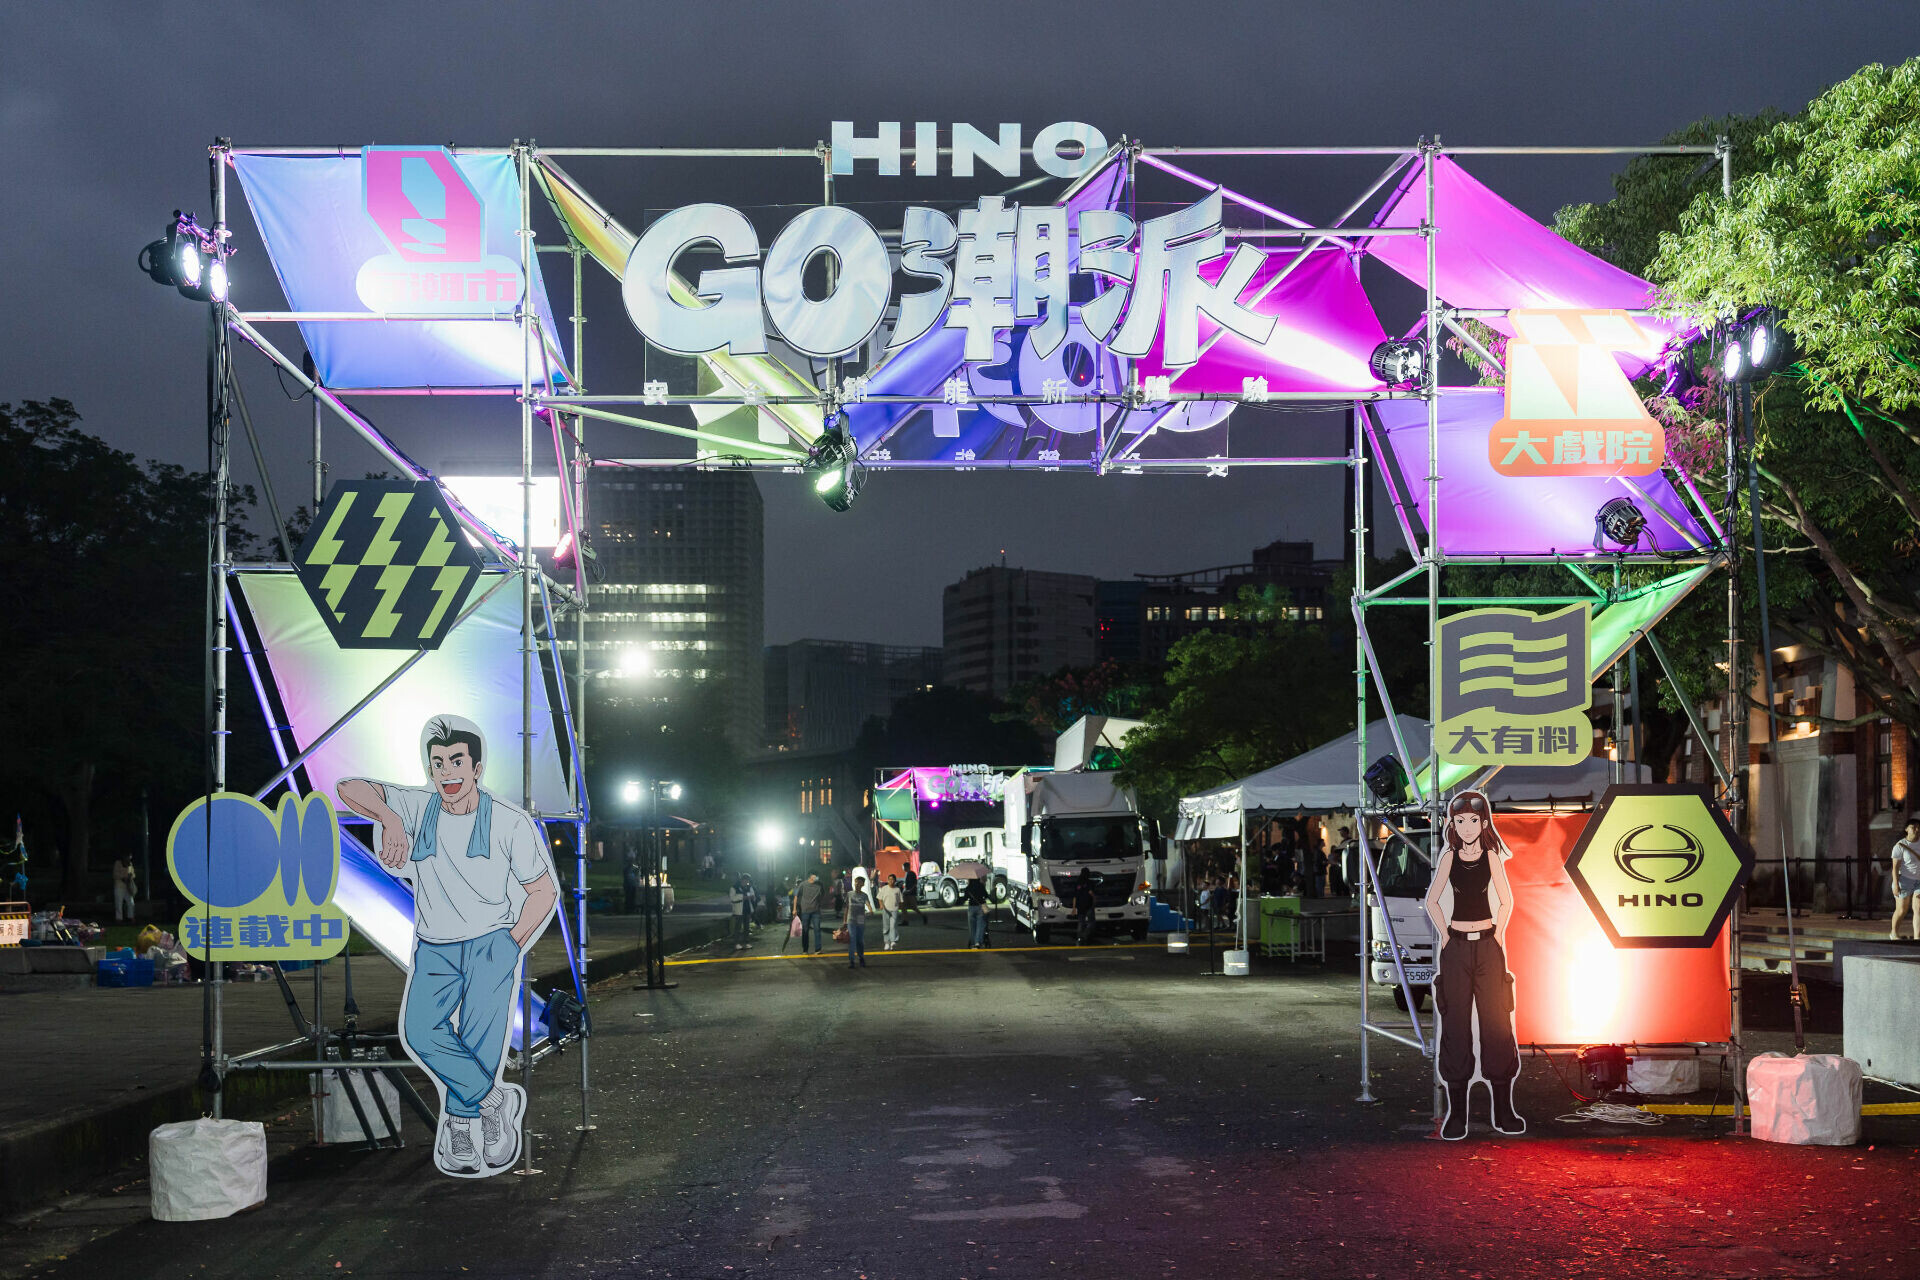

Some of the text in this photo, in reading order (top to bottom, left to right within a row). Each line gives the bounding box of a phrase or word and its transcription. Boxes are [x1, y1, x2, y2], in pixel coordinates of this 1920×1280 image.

[831, 121, 1108, 178] HINO
[622, 184, 1279, 368] GO潮派
[1500, 430, 1653, 465] 大戲院
[1448, 726, 1579, 754] 大有料
[1618, 893, 1704, 907] HINO
[185, 914, 343, 948] 連載中
[1406, 971, 1434, 981] FS-589
